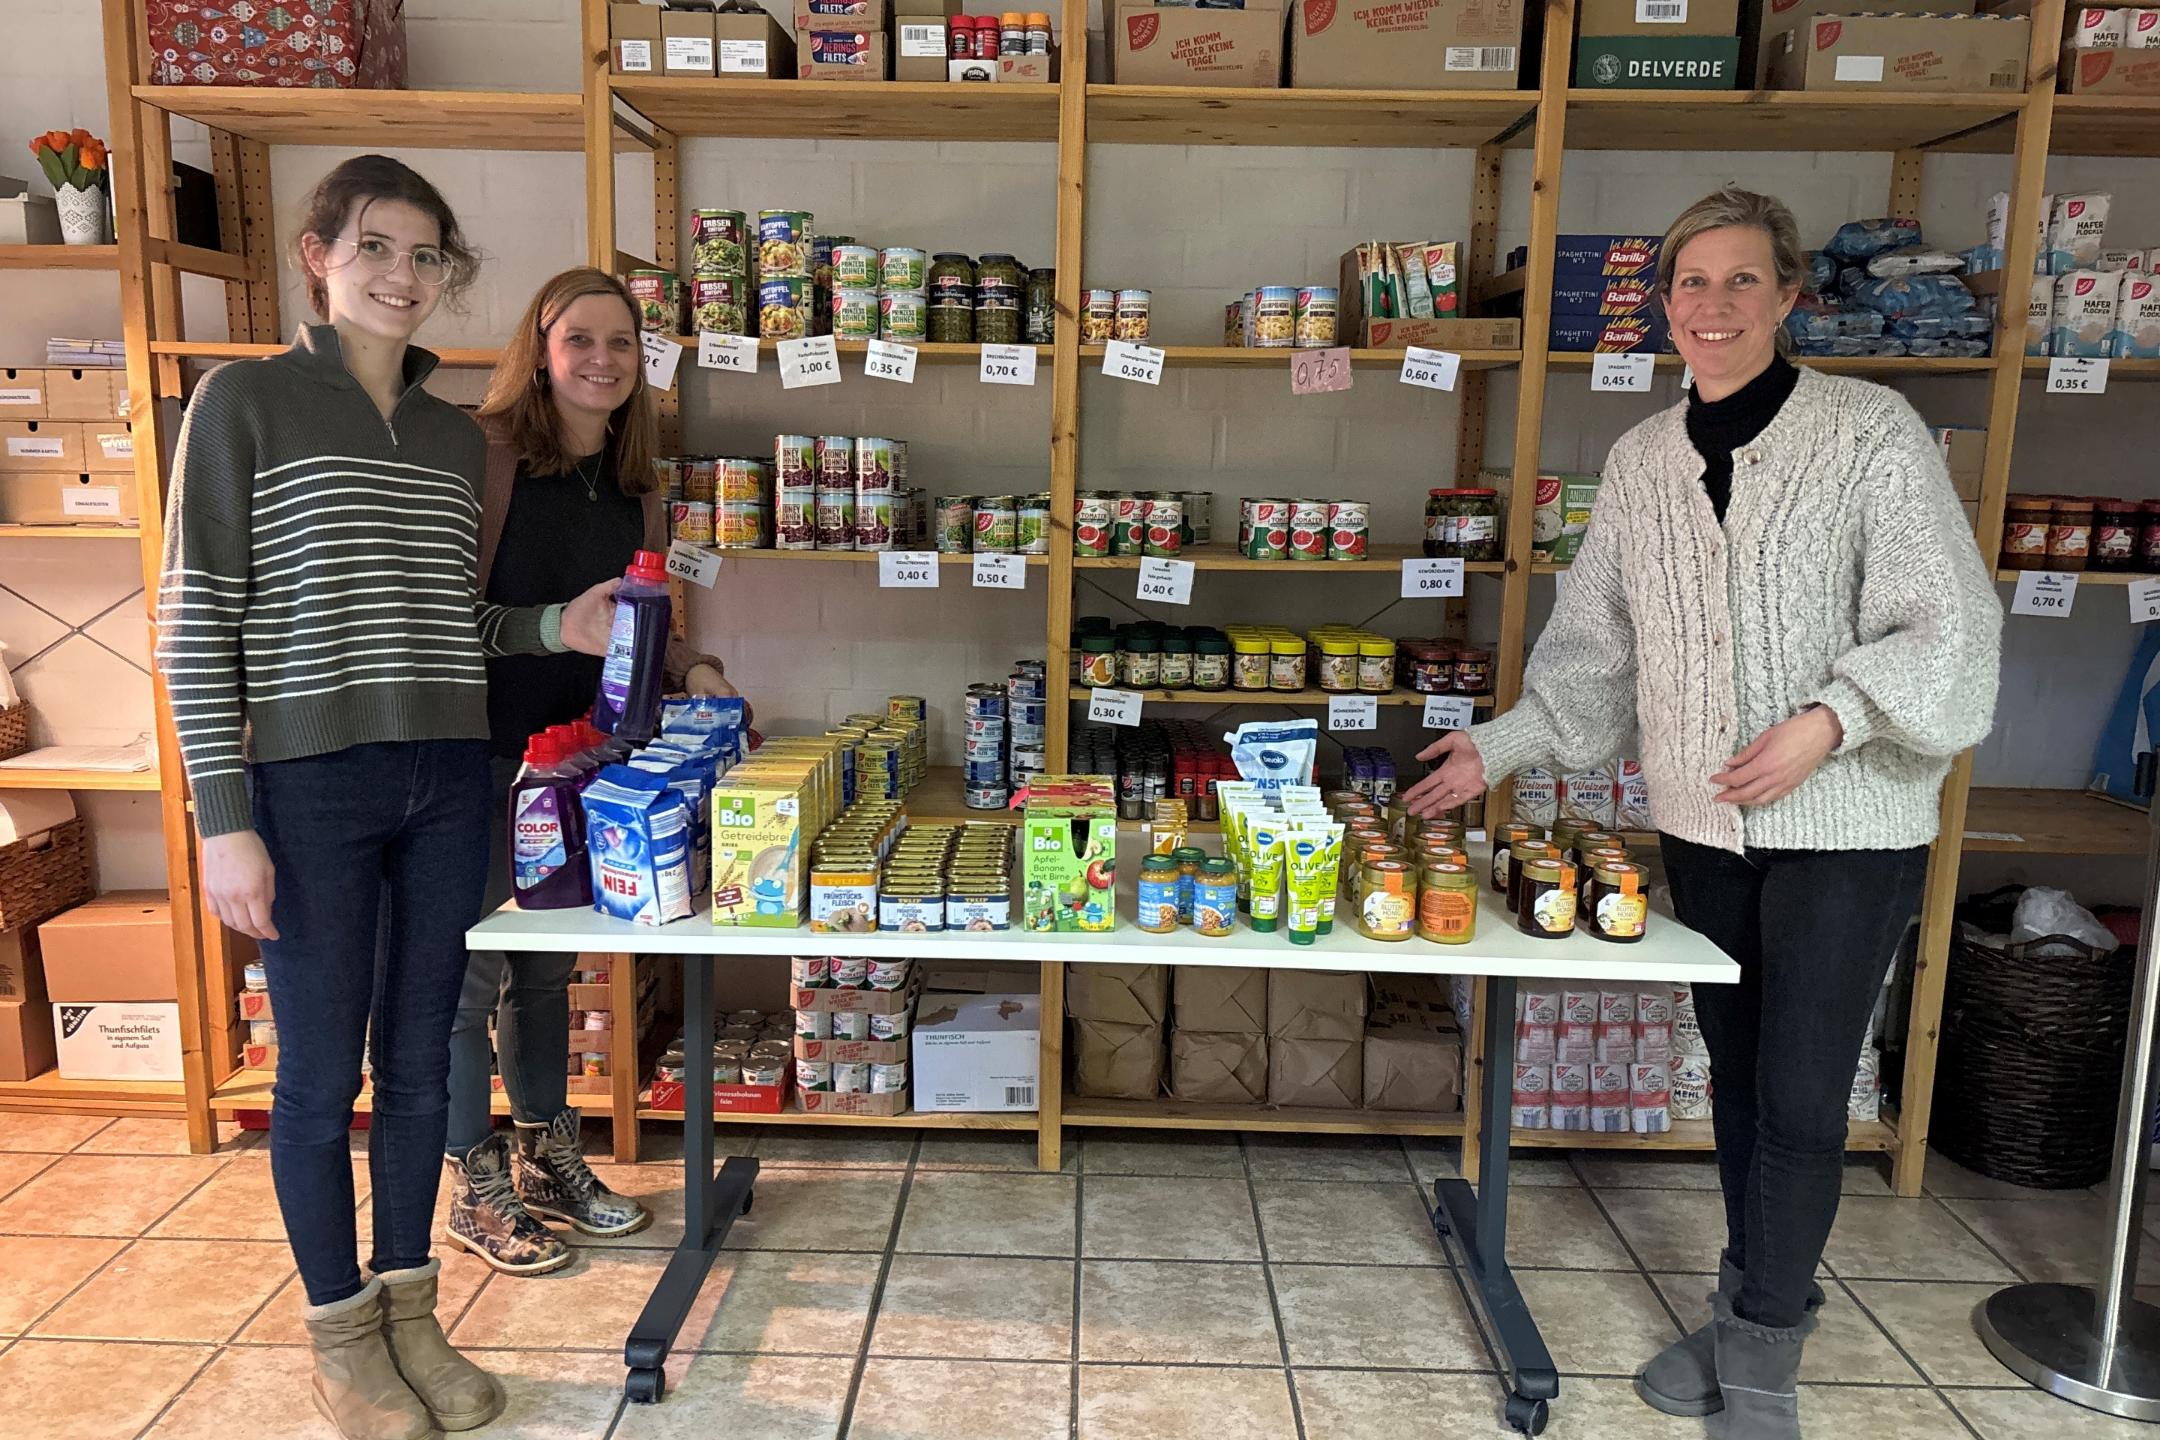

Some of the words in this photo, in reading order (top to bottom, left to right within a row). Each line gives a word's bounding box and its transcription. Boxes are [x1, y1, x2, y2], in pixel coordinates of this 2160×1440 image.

[820, 4, 844, 14] FILETS
[1353, 10, 1370, 21] ICH
[1372, 4, 1402, 16] KOMM
[1366, 14, 1394, 28] KEINE
[1396, 11, 1428, 25] FRAGE!
[1175, 38, 1192, 50] ICH
[1193, 31, 1222, 46] KOMM
[2094, 32, 2120, 40] HAFER
[824, 42, 857, 53] HERINGS
[1208, 40, 1235, 54] KEINE
[823, 52, 847, 64] FILETS
[1186, 56, 1217, 68] FRAGE!
[1628, 60, 1722, 78] DELVERDE
[702, 219, 731, 228] ERBSEN
[2077, 221, 2104, 230] HAFER
[1610, 252, 1646, 264] Barilla
[841, 260, 864, 268] PRINZESS
[886, 261, 908, 270] PRINZESS
[841, 268, 864, 276] BOHNEN
[886, 269, 908, 278] BOHNEN
[700, 282, 728, 292] ERBSEN
[1606, 292, 1643, 303] Barilla
[2029, 302, 2048, 310] AFER
[2084, 300, 2111, 309] HAFER
[842, 308, 865, 316] PRINZESS
[842, 314, 865, 322] BOHNEN
[892, 315, 916, 324] BOHNEN
[1604, 332, 1640, 342] Barilla
[708, 354, 730, 365] 1,00
[732, 356, 740, 366] €
[800, 362, 822, 374] 1,00
[825, 360, 832, 371] €
[870, 361, 892, 374] 0,35
[896, 366, 902, 376] €
[986, 364, 1009, 377] 0,70
[1011, 366, 1018, 376] €
[1122, 364, 1144, 379] 0,50
[1146, 370, 1154, 380] €
[1296, 359, 1340, 388] 0,75
[1405, 368, 1429, 382] 0,60
[1430, 372, 1438, 382] €
[1602, 376, 1624, 386] 0,45
[1628, 376, 1635, 386] €
[2055, 379, 2078, 390] 0,35
[2080, 379, 2088, 390] €
[824, 459, 847, 468] BOHNEN
[694, 477, 712, 486] MAIS
[727, 476, 746, 486] MAIS
[690, 517, 708, 526] MAIS
[724, 518, 742, 528] MAIS
[669, 560, 691, 574] 0,50
[692, 568, 700, 578] €
[898, 570, 920, 581] 0,40
[922, 571, 928, 580] €
[976, 573, 999, 584] 0,50
[1001, 574, 1008, 584] €
[1143, 583, 1165, 595] 0,40
[1168, 586, 1174, 596] €
[1420, 579, 1442, 590] 0,80
[1444, 579, 1452, 590] €
[2032, 596, 2054, 608] 0,70
[2057, 598, 2064, 607] €
[1094, 706, 1116, 718] 0,30
[1118, 710, 1124, 719] €
[1334, 718, 1356, 729] 0,30
[1358, 718, 1365, 728] €
[1428, 716, 1450, 727] 0,30
[1452, 718, 1460, 727] €
[1514, 780, 1552, 790] Weizen
[1570, 782, 1610, 790] Weizen
[1520, 791, 1547, 799] MEHL
[720, 809, 754, 826] Bio
[517, 822, 558, 833] COLOR
[721, 830, 790, 842] Getreidebrei
[1034, 836, 1062, 850] Bio
[1034, 856, 1060, 864] Apfel-
[1250, 851, 1278, 862] OLIVE
[1290, 862, 1320, 871] OLIVE
[1033, 872, 1047, 880] mit
[604, 874, 638, 896] FEIN
[824, 892, 864, 900] FRÜHSTÜCKS-
[98, 1024, 160, 1034] Thunfischfilets
[1672, 1080, 1704, 1091] Weizen
[1674, 1090, 1701, 1099] MEHL
